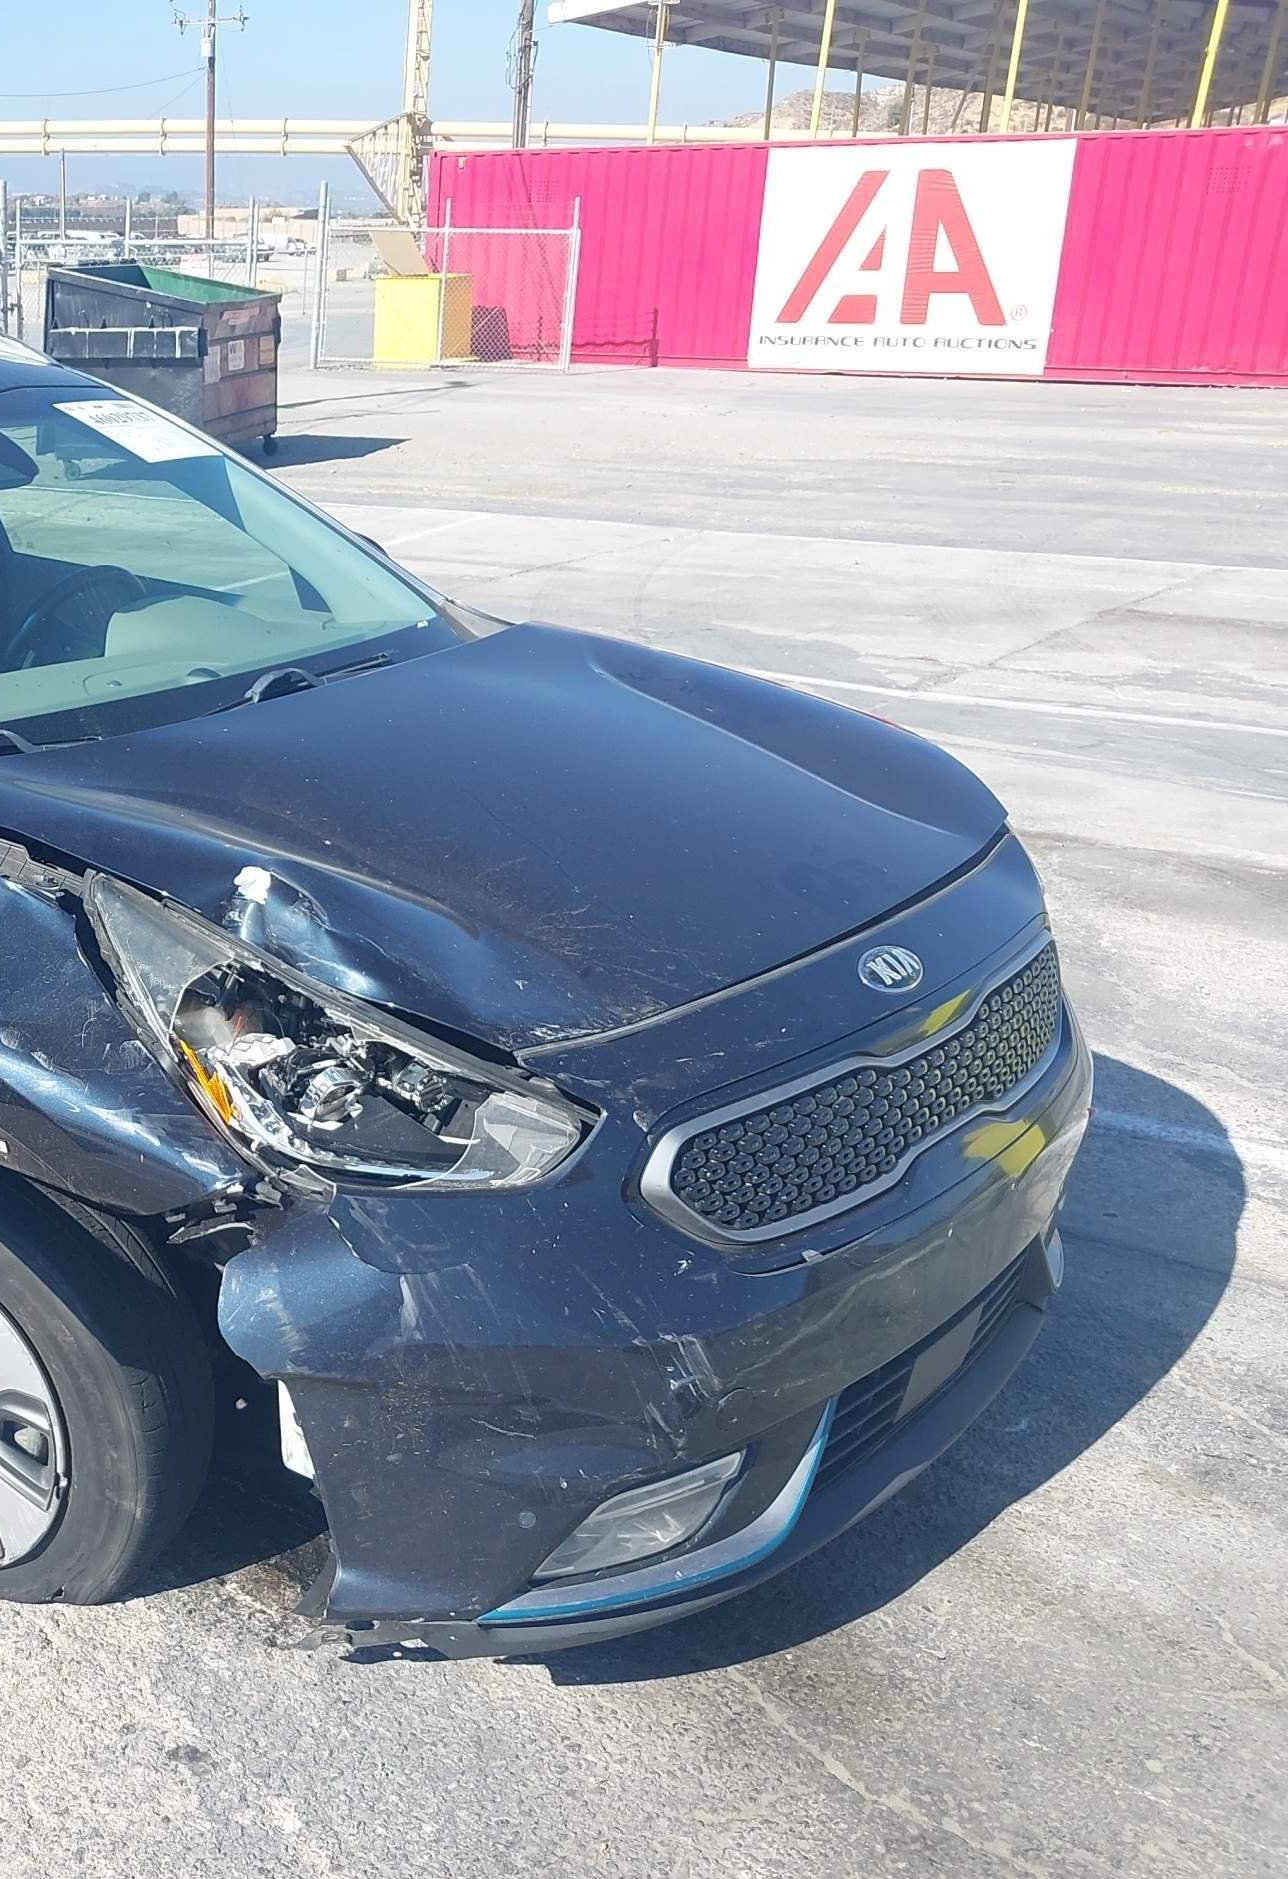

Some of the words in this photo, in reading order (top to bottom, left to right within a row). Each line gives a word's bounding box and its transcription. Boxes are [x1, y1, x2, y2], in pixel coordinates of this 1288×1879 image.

[759, 335, 865, 347] INSURANCE
[872, 335, 926, 348] AUTO
[933, 337, 1037, 350] AUCTIONS
